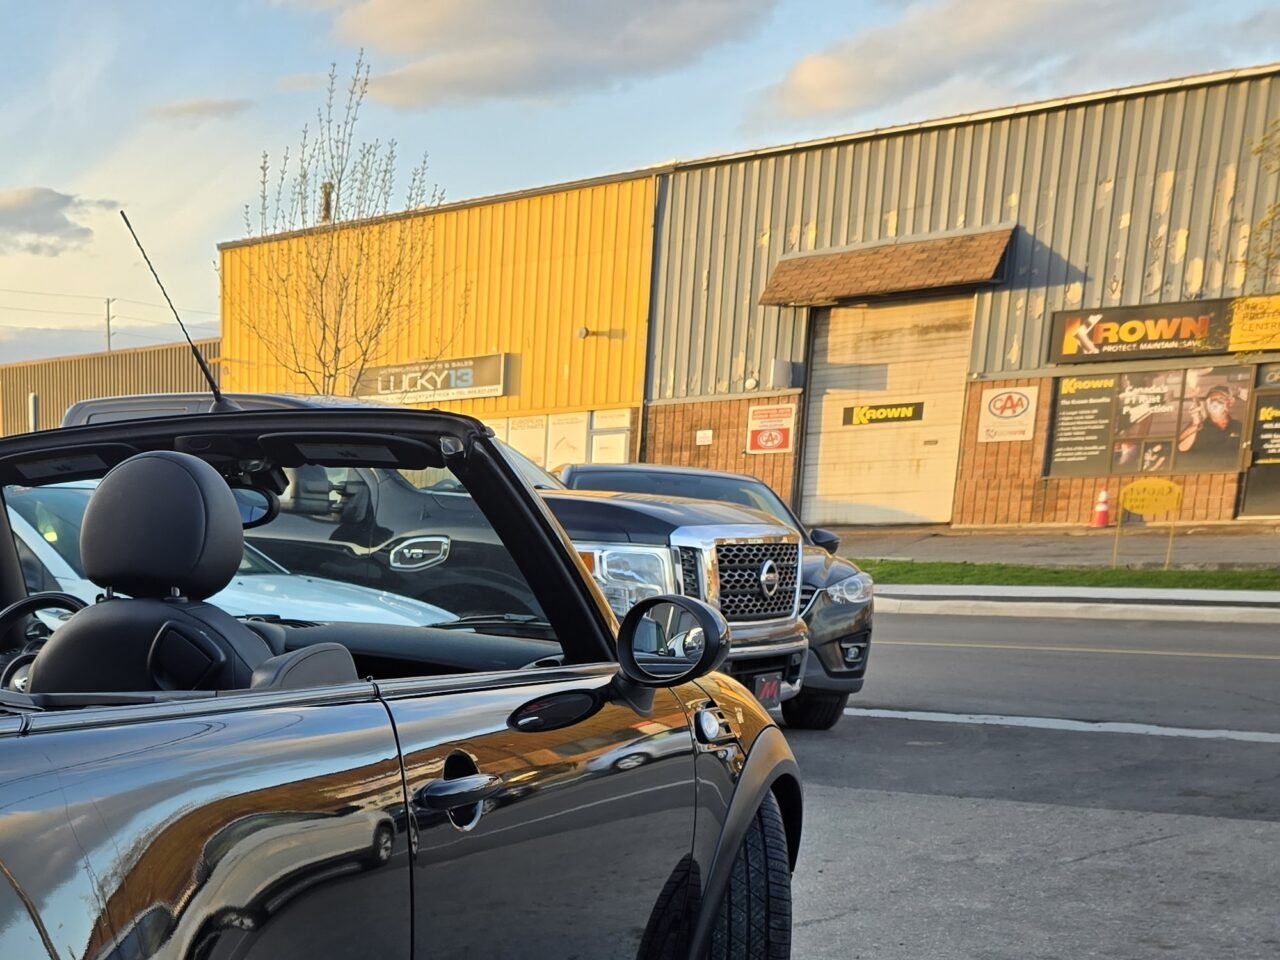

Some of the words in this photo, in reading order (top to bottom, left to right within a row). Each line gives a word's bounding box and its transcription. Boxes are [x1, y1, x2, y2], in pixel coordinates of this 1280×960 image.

[1062, 314, 1210, 355] KROWN
[1061, 378, 1114, 394] KROWN
[993, 394, 1024, 415] CAA
[852, 406, 913, 425] KROWN
